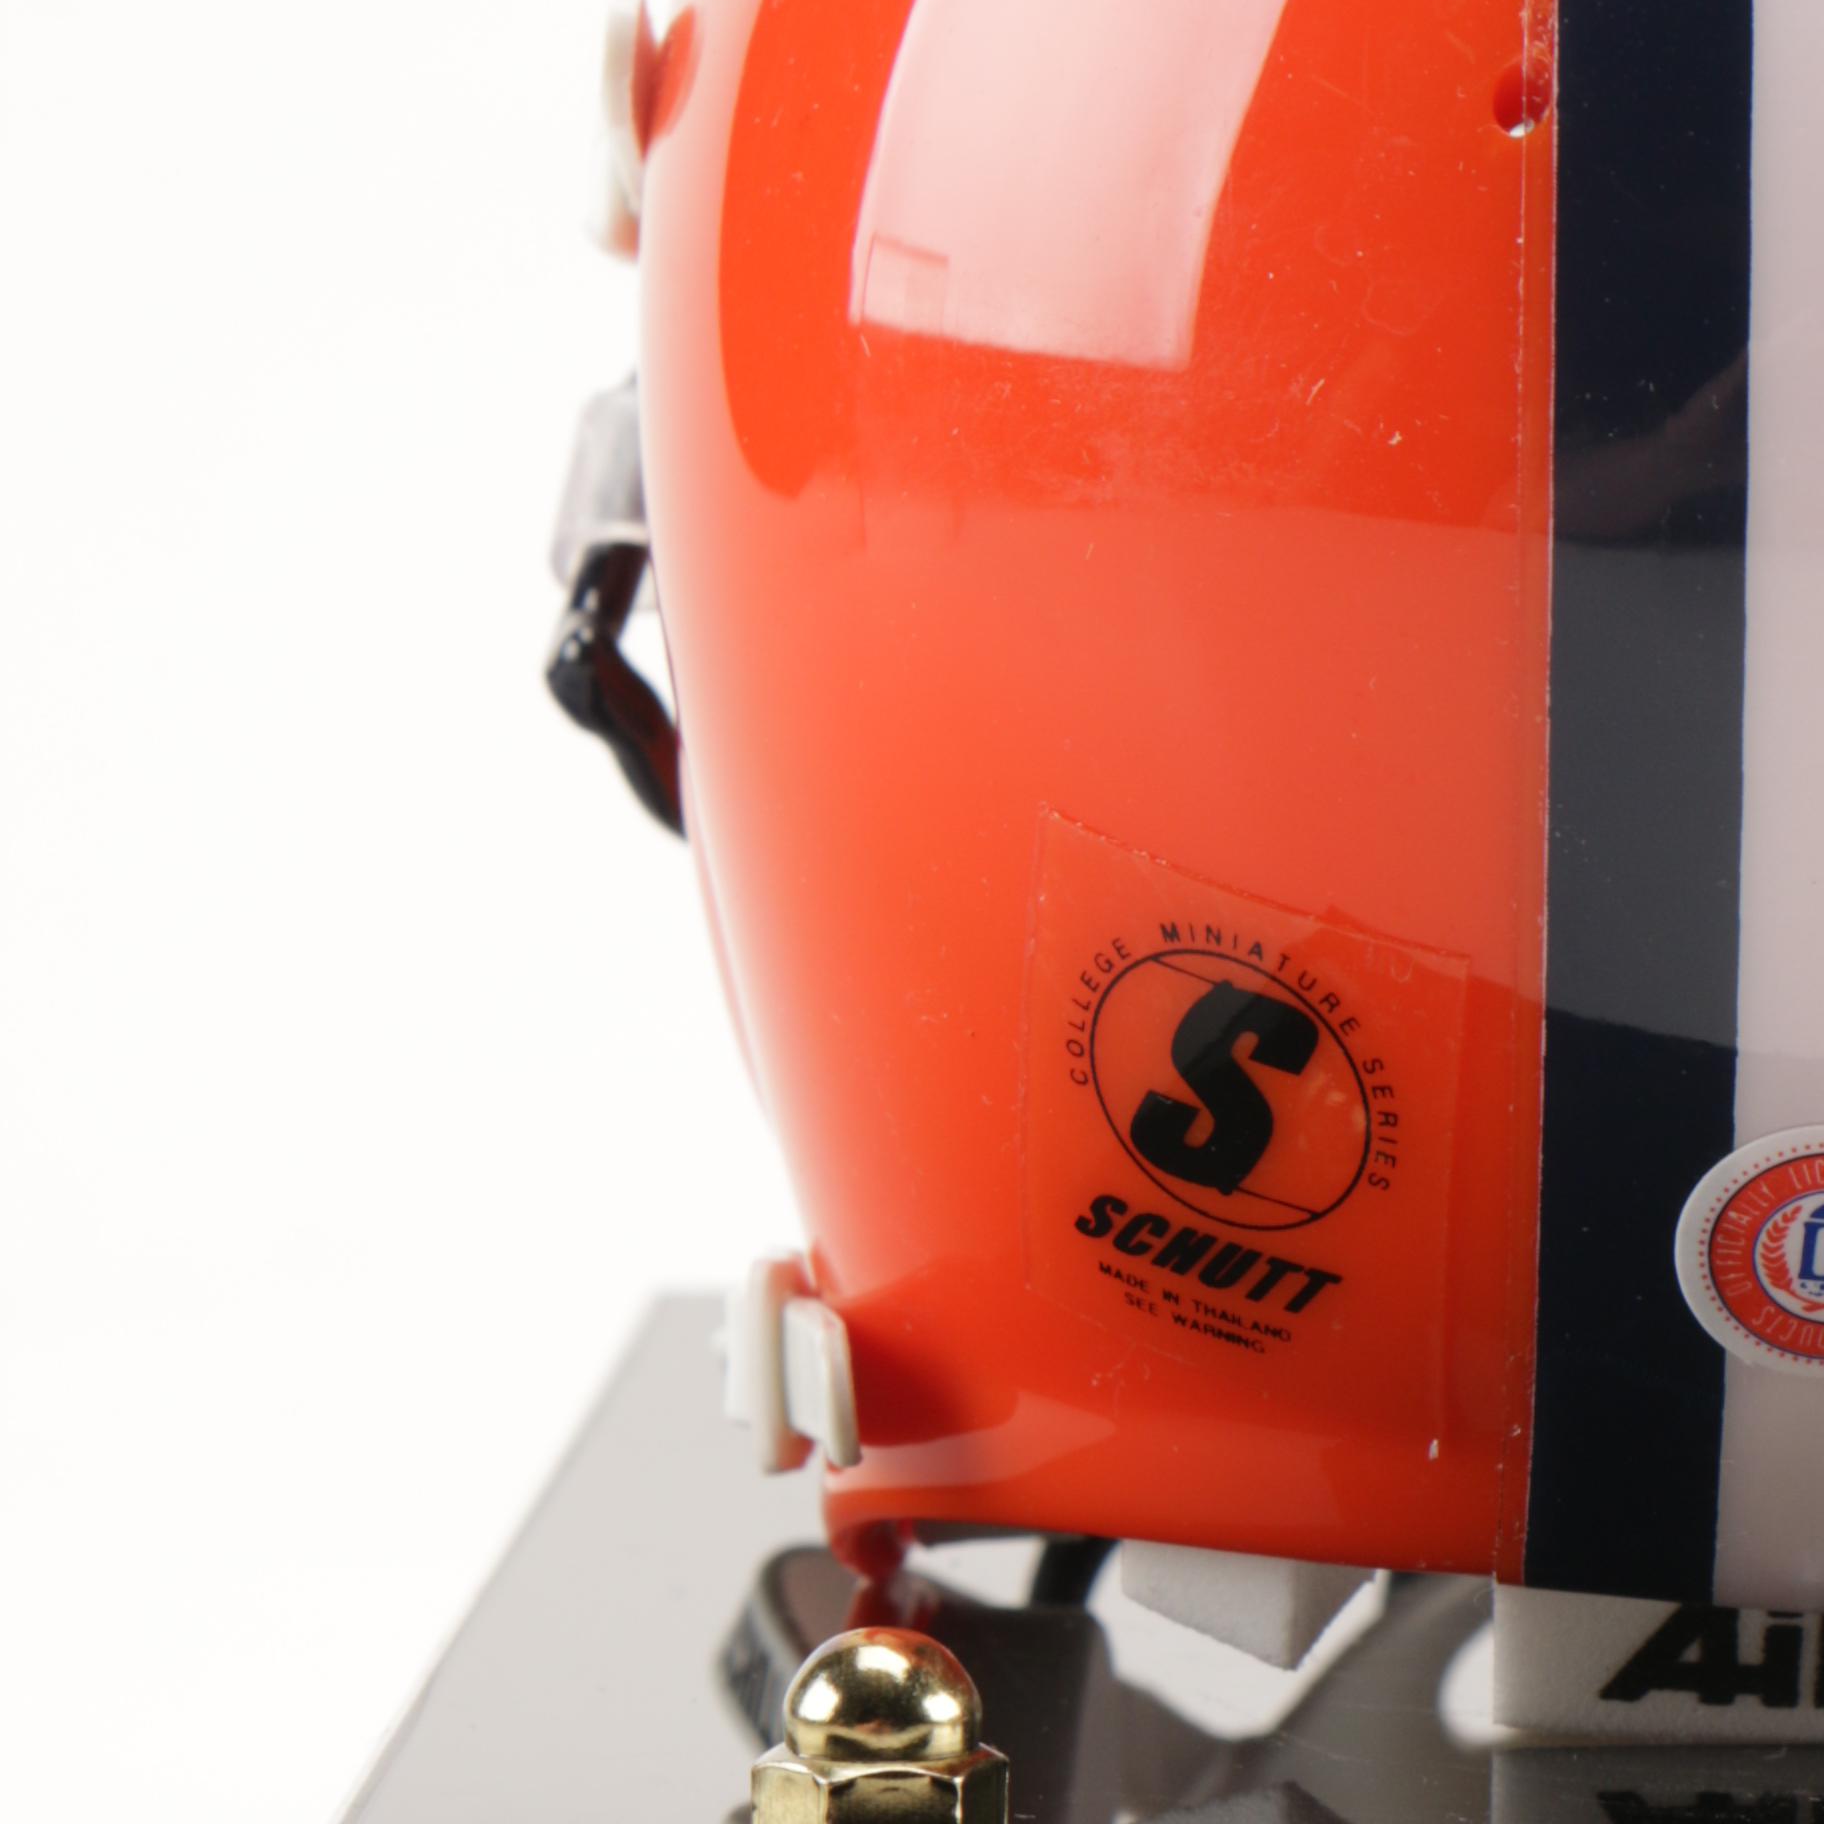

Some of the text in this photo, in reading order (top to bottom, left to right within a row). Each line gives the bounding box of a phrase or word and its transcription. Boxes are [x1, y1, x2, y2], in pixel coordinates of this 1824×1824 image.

[1065, 922, 1398, 1191] COLLEGE MINIATURE SERIES
[1074, 1194, 1343, 1314] SCHUTT
[1716, 1184, 1776, 1297] OFFICIALLY
[1098, 1261, 1292, 1342] MADE IN THAILAND
[1124, 1292, 1265, 1354] SEE WARNING
